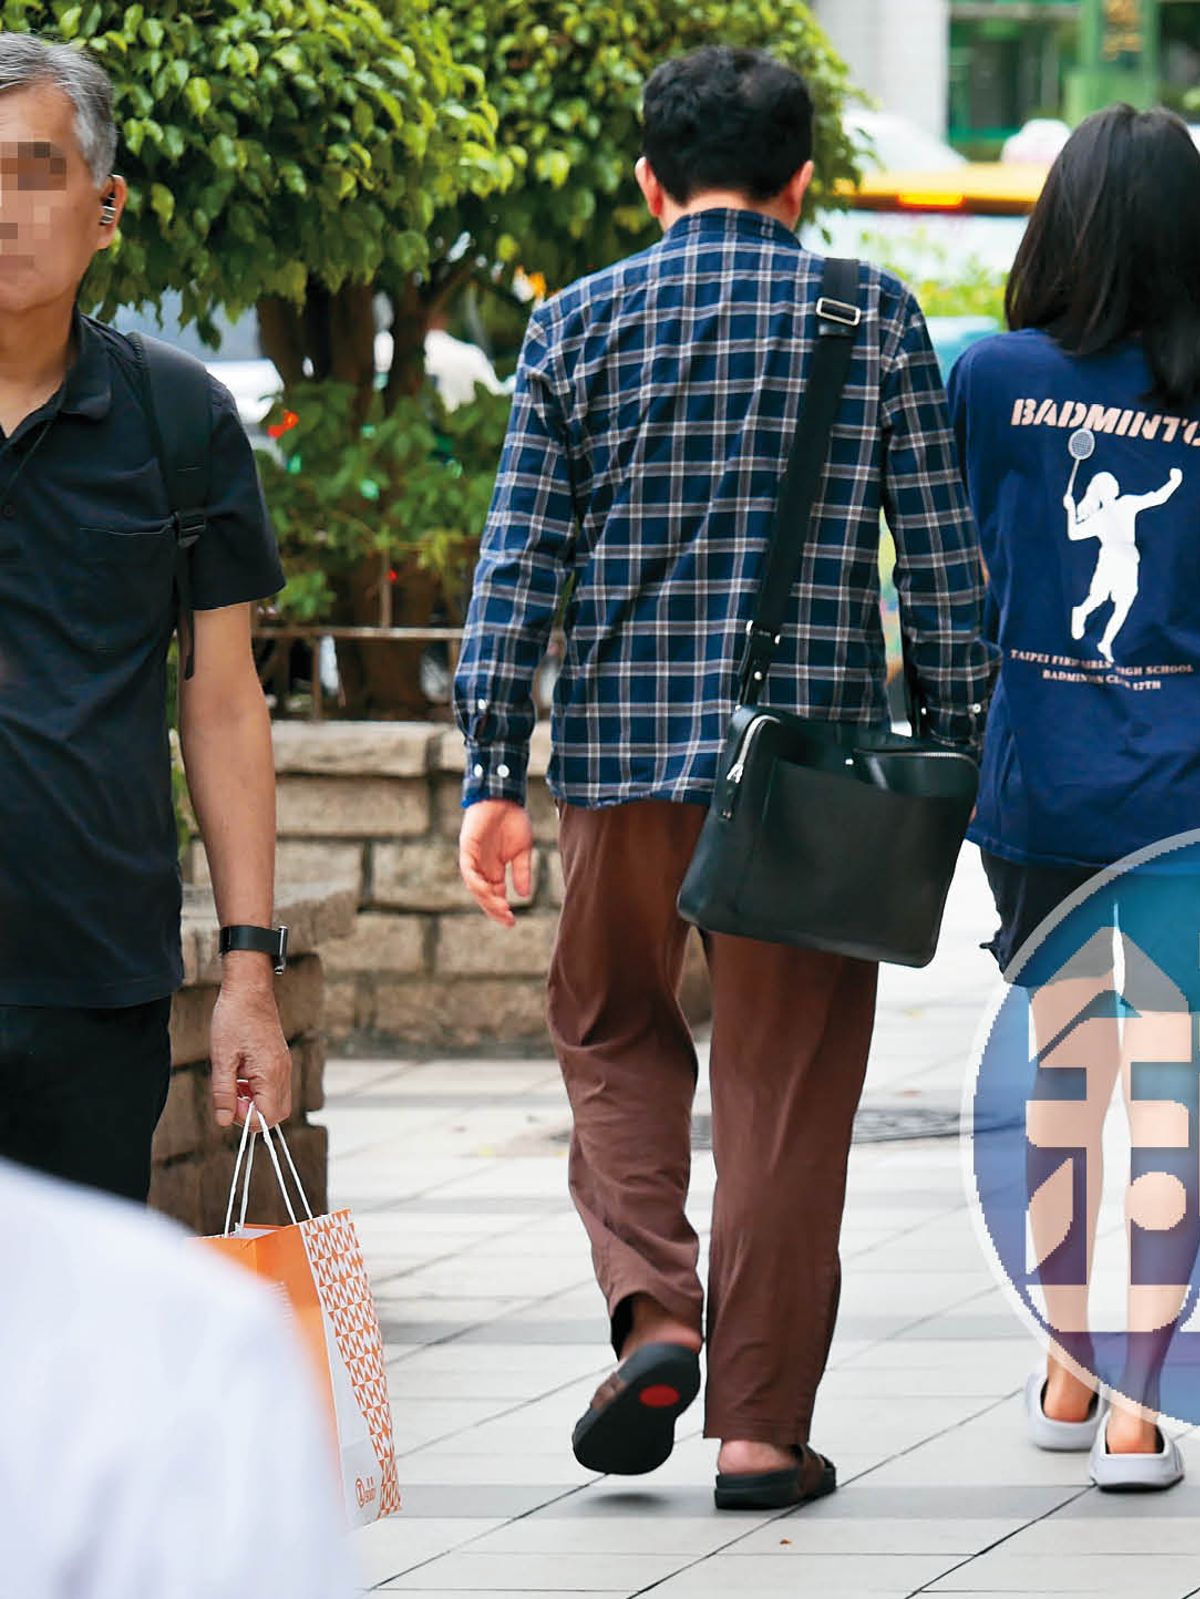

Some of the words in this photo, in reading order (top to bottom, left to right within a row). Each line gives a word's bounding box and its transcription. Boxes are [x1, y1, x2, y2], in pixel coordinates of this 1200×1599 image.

[1009, 648, 1050, 665] TAIPEI
[1145, 664, 1194, 676] SCHOOL
[1042, 669, 1104, 684] BADMINN
